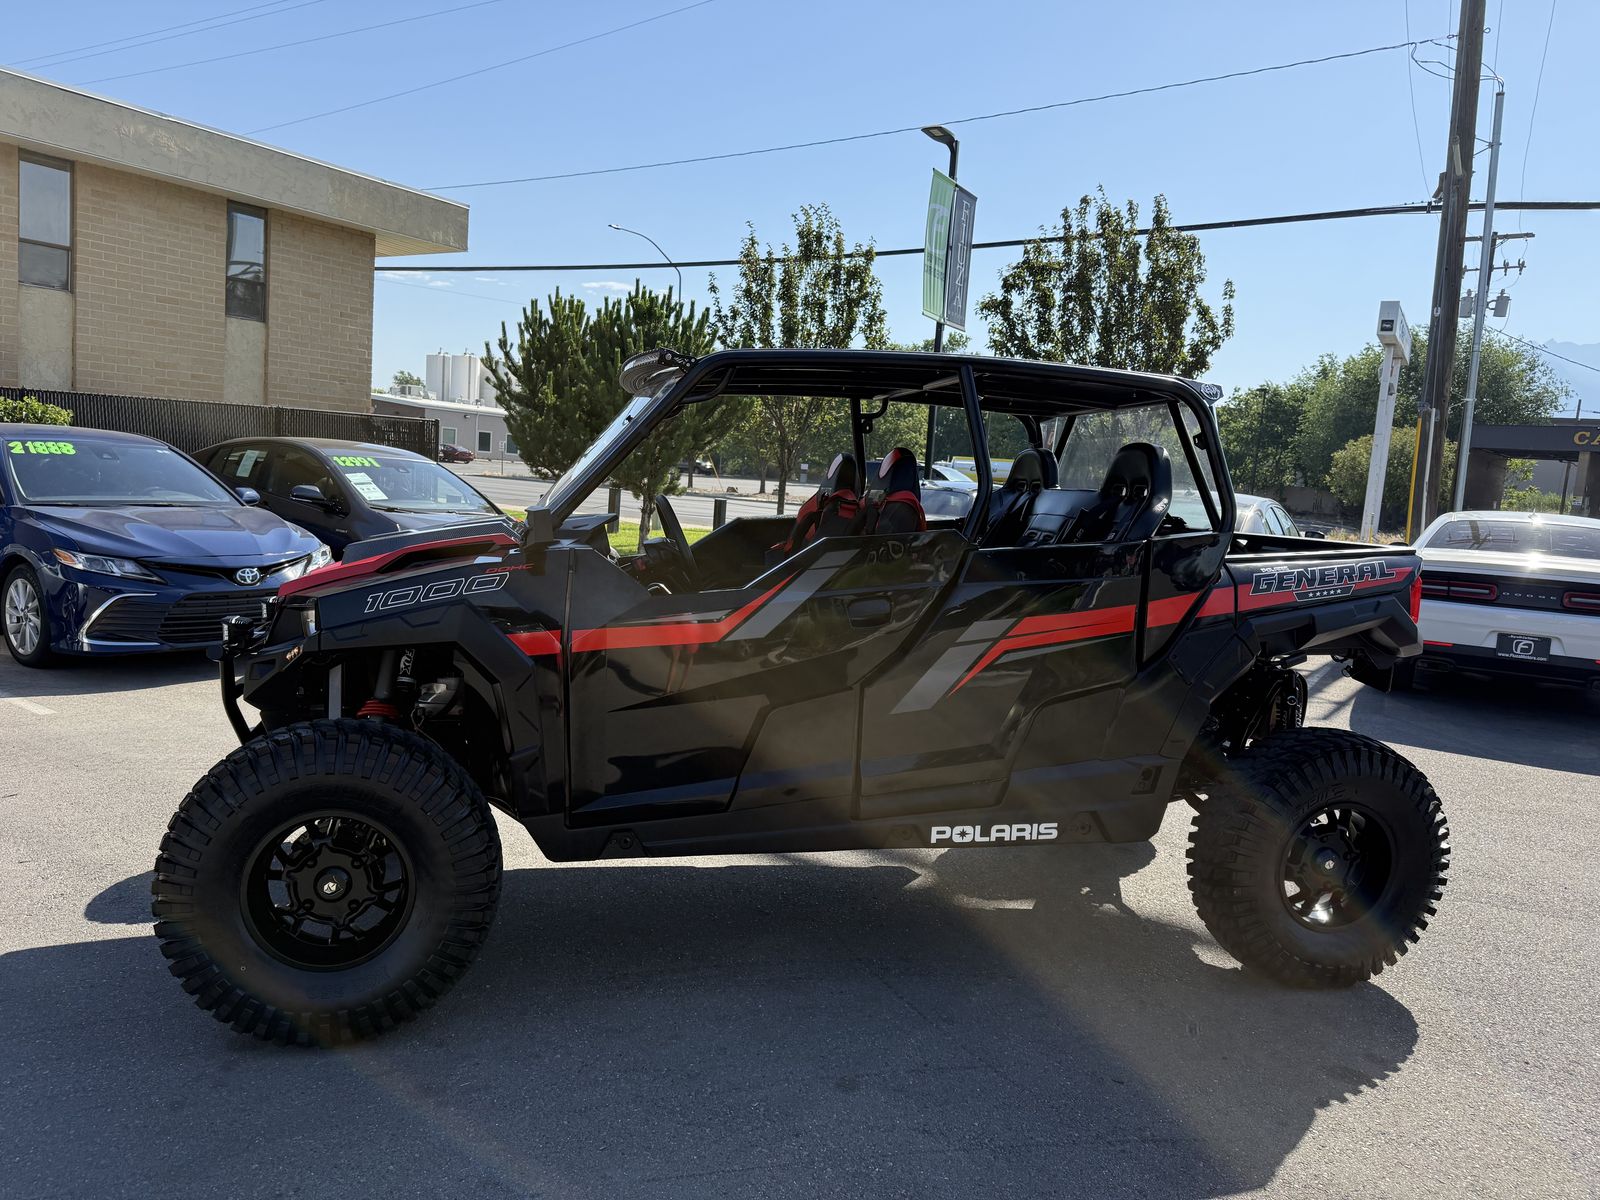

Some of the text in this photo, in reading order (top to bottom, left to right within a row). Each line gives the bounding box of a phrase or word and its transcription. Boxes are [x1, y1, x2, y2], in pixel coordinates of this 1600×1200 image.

[7, 440, 76, 455] 21888
[333, 456, 381, 468] 12991
[485, 563, 536, 574] DOHC
[1250, 560, 1396, 596] GENERAL
[364, 572, 510, 613] 1000
[930, 822, 1059, 844] POLARIS
